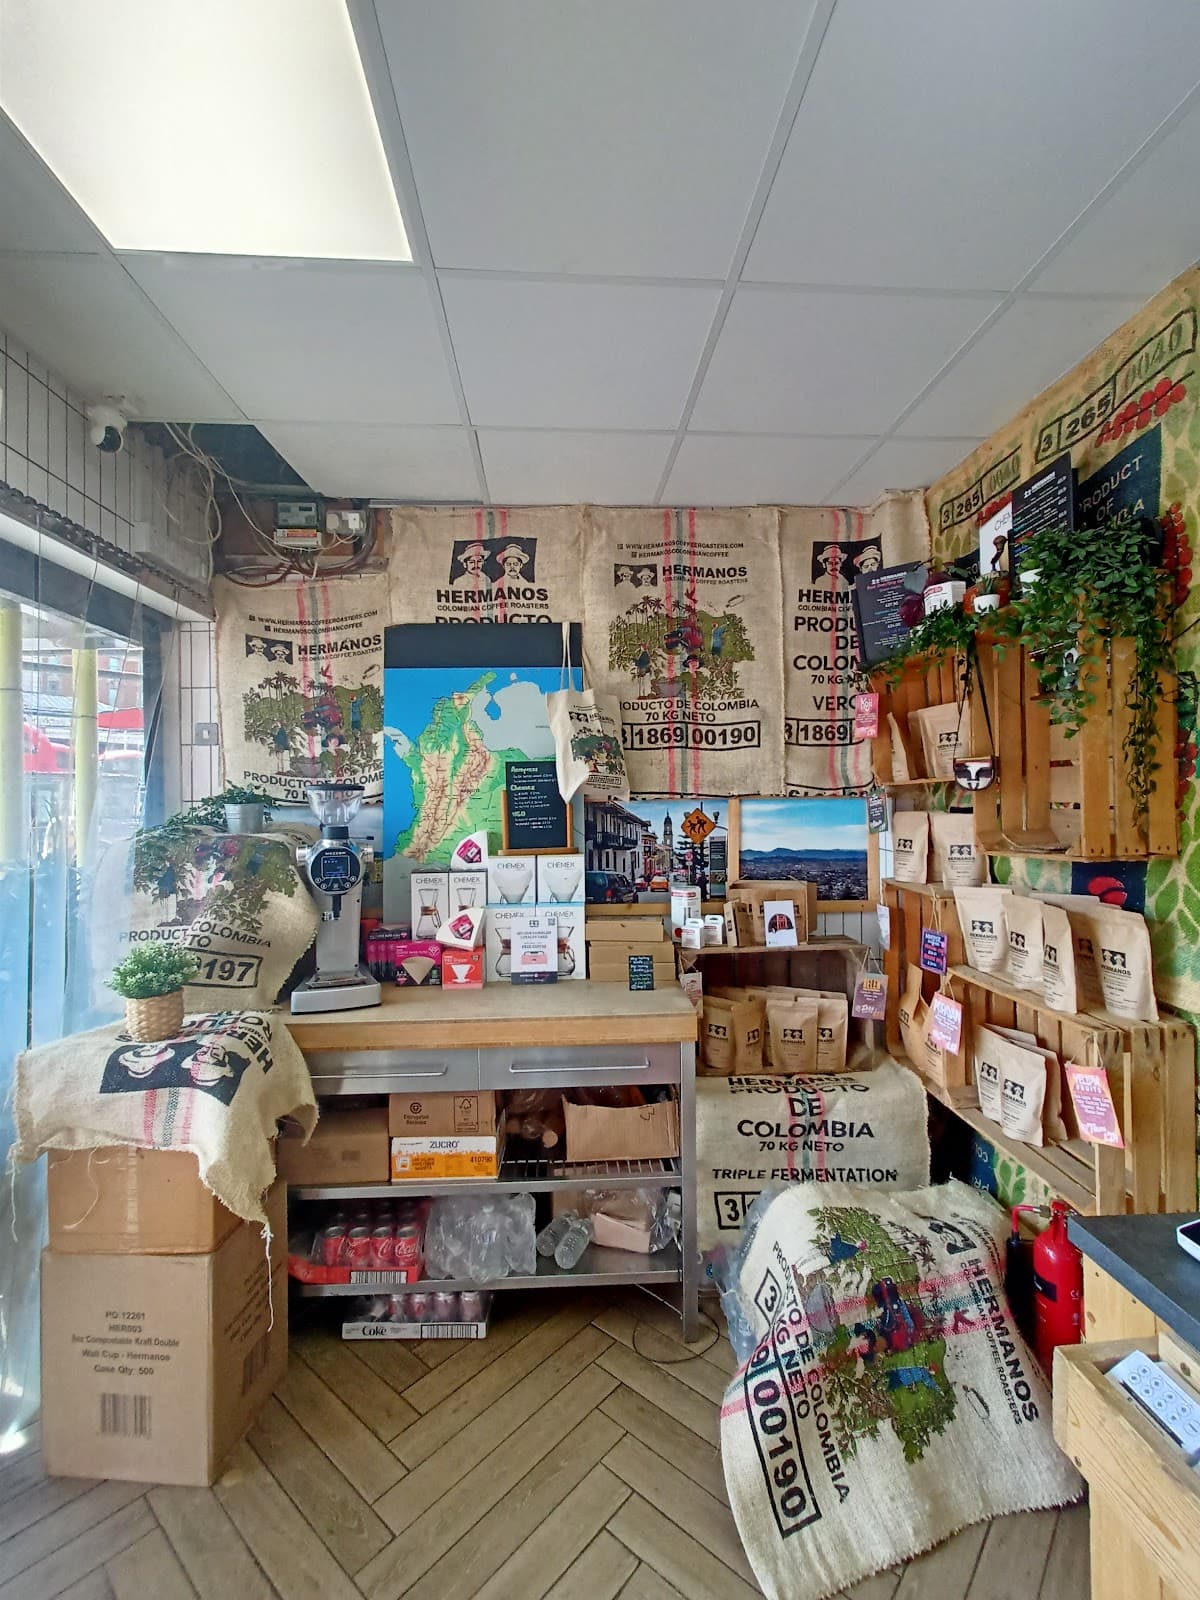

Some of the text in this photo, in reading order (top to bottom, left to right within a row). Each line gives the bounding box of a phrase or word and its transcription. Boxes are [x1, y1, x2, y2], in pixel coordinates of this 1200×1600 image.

[662, 564, 747, 578] HERMANOS
[436, 586, 549, 604] HERMANOS
[798, 589, 853, 604] HERM
[437, 601, 549, 612] COLOMBIAN COFFEE ROASTERS
[297, 634, 382, 656] HERMANOS
[811, 675, 825, 685] 70
[828, 675, 843, 685] KG
[677, 700, 691, 709] DE
[694, 700, 760, 711] COLOMBIA
[645, 711, 716, 722] 70 KG NETO
[634, 726, 684, 745] 1869
[691, 726, 756, 746] 00190
[800, 724, 849, 741] 1869
[284, 788, 299, 799] 70
[547, 861, 575, 869] CHEMEX
[454, 876, 480, 884] CHEMEX
[788, 1097, 822, 1117] DE
[737, 1119, 875, 1138] COLOMBIA
[759, 1140, 844, 1152] 70 KG NETO
[712, 1167, 899, 1183] TRIPLE FERMENTATION
[724, 1198, 740, 1222] 3
[764, 1285, 778, 1313] 3
[362, 1325, 387, 1336] Coke
[154, 1338, 179, 1348] Double
[967, 1257, 1039, 1423] HERMANOS
[127, 1351, 170, 1362] Hermanos
[984, 1323, 1003, 1366] COFFEE
[997, 1365, 1023, 1426] ROASTERS
[780, 1351, 811, 1420] NETO
[794, 1329, 815, 1365] DE
[807, 1370, 851, 1505] COLOMBIA
[752, 1378, 807, 1520] 00190
